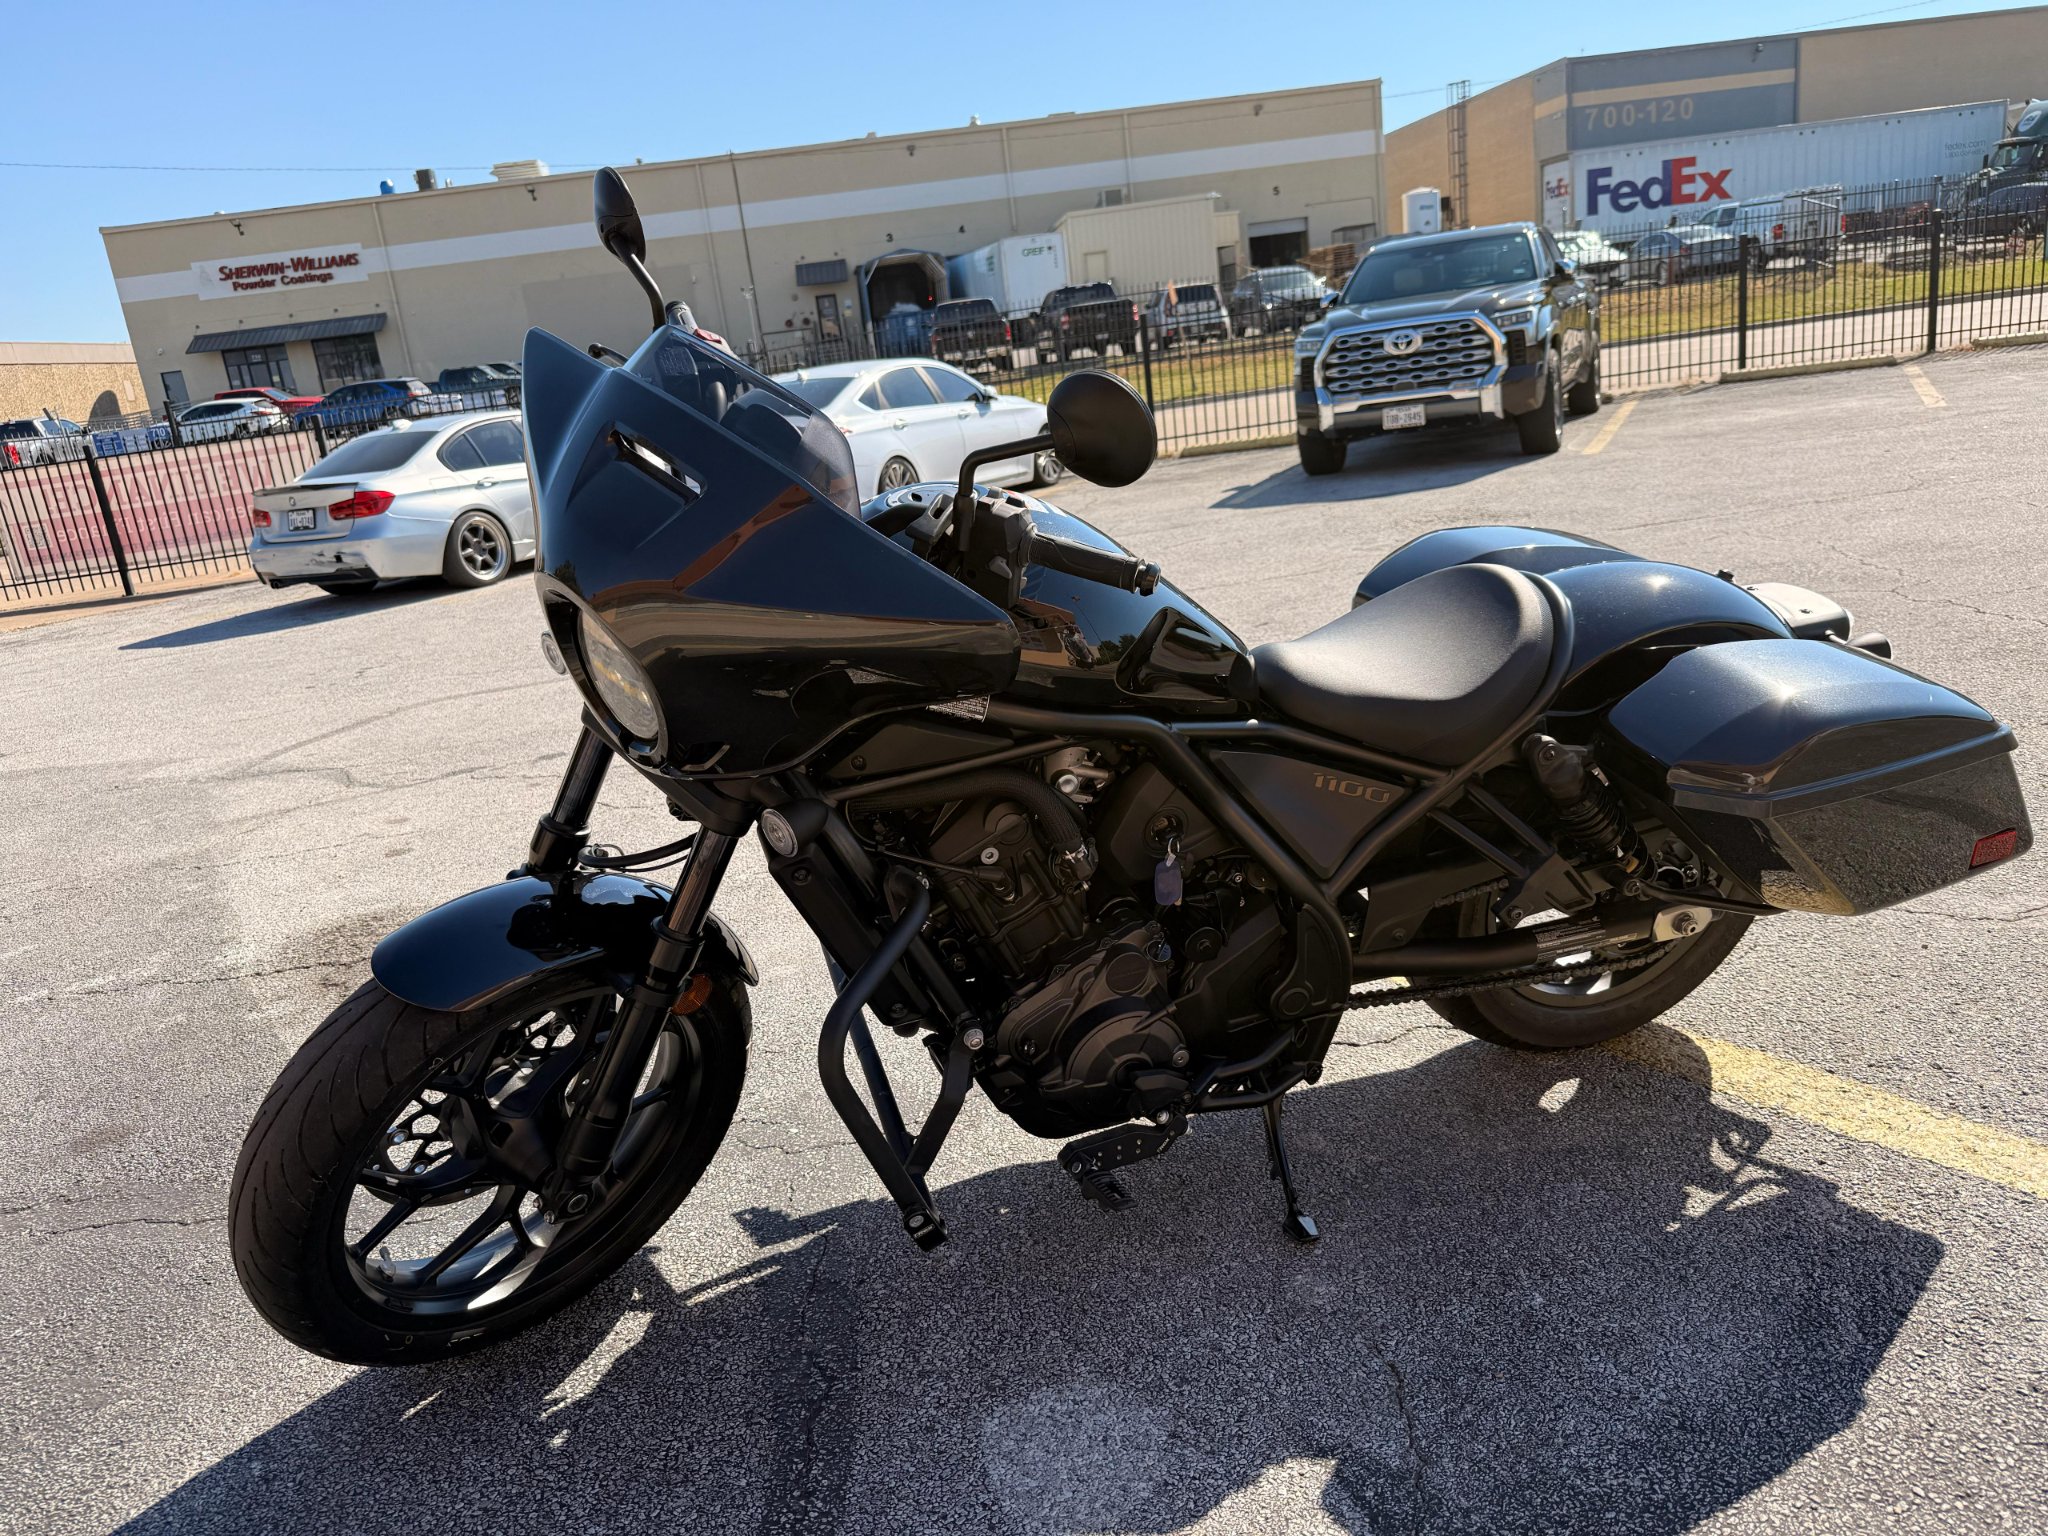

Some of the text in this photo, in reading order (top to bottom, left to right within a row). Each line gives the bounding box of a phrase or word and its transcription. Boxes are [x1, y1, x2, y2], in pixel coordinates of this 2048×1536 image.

[1585, 97, 1694, 131] 700-120
[1587, 156, 1733, 216] FedEx
[886, 233, 894, 243] 3
[958, 225, 966, 234] 4
[218, 253, 359, 281] SHERWIN-WILLIAMS
[232, 272, 334, 291] Powder Coatings
[151, 427, 166, 437] 710
[1313, 772, 1390, 803] 1100
